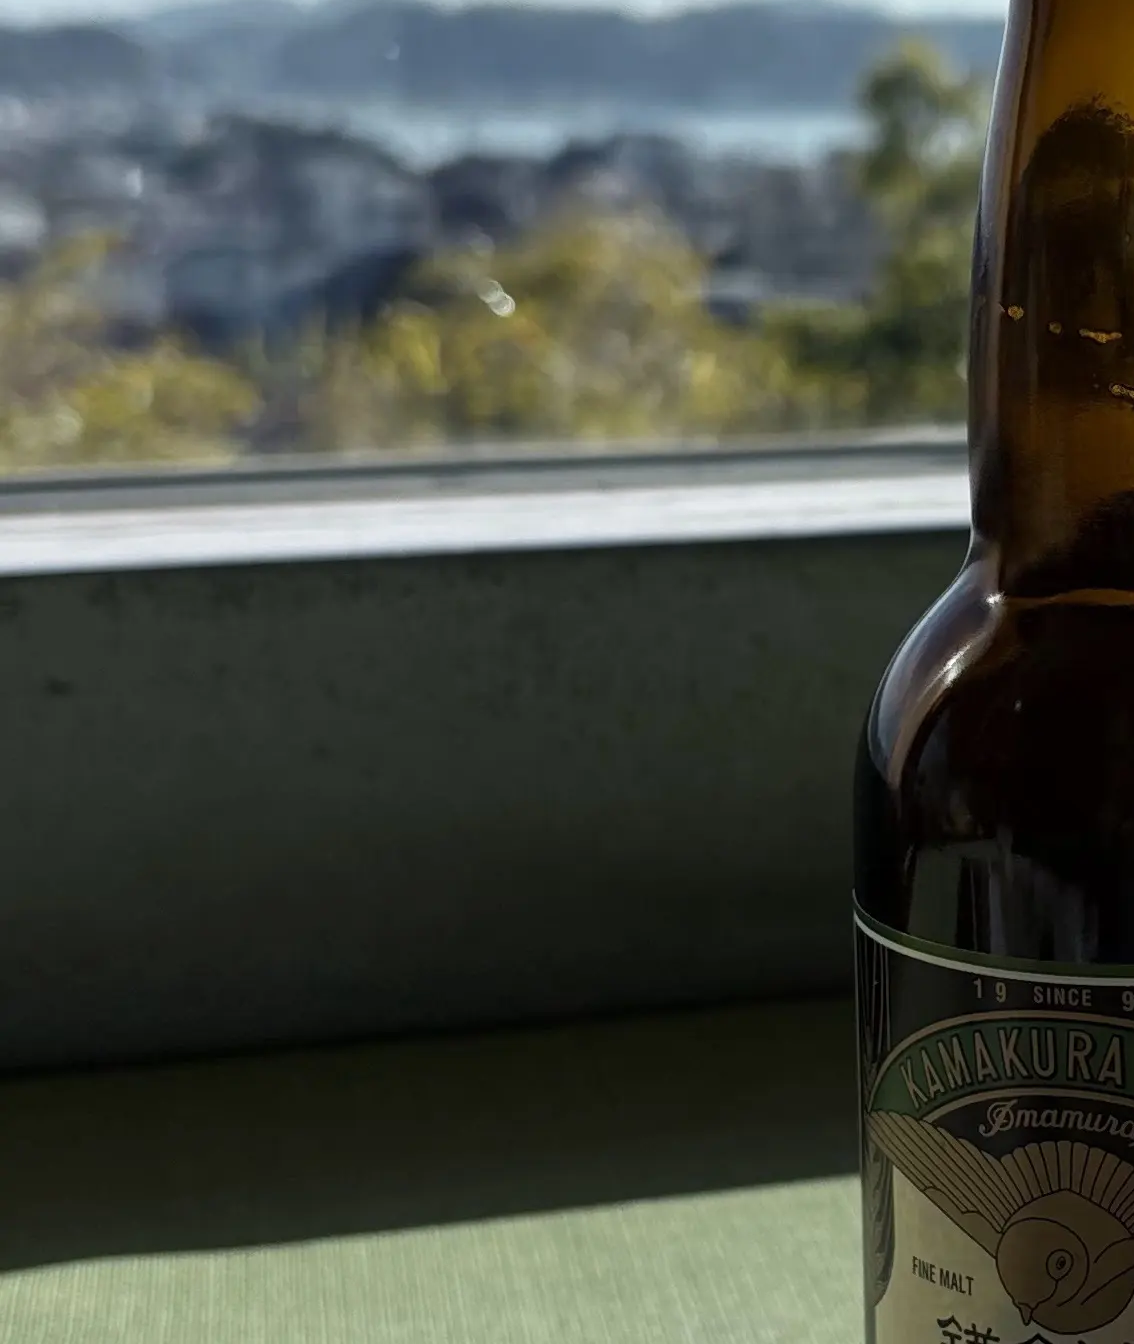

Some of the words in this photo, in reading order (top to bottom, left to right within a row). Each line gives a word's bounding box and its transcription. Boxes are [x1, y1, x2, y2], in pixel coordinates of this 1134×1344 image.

[1033, 985, 1093, 1008] SINCE
[902, 1028, 1123, 1109] KAMAKURA
[911, 1255, 937, 1284] FINE
[939, 1269, 974, 1296] MALT
